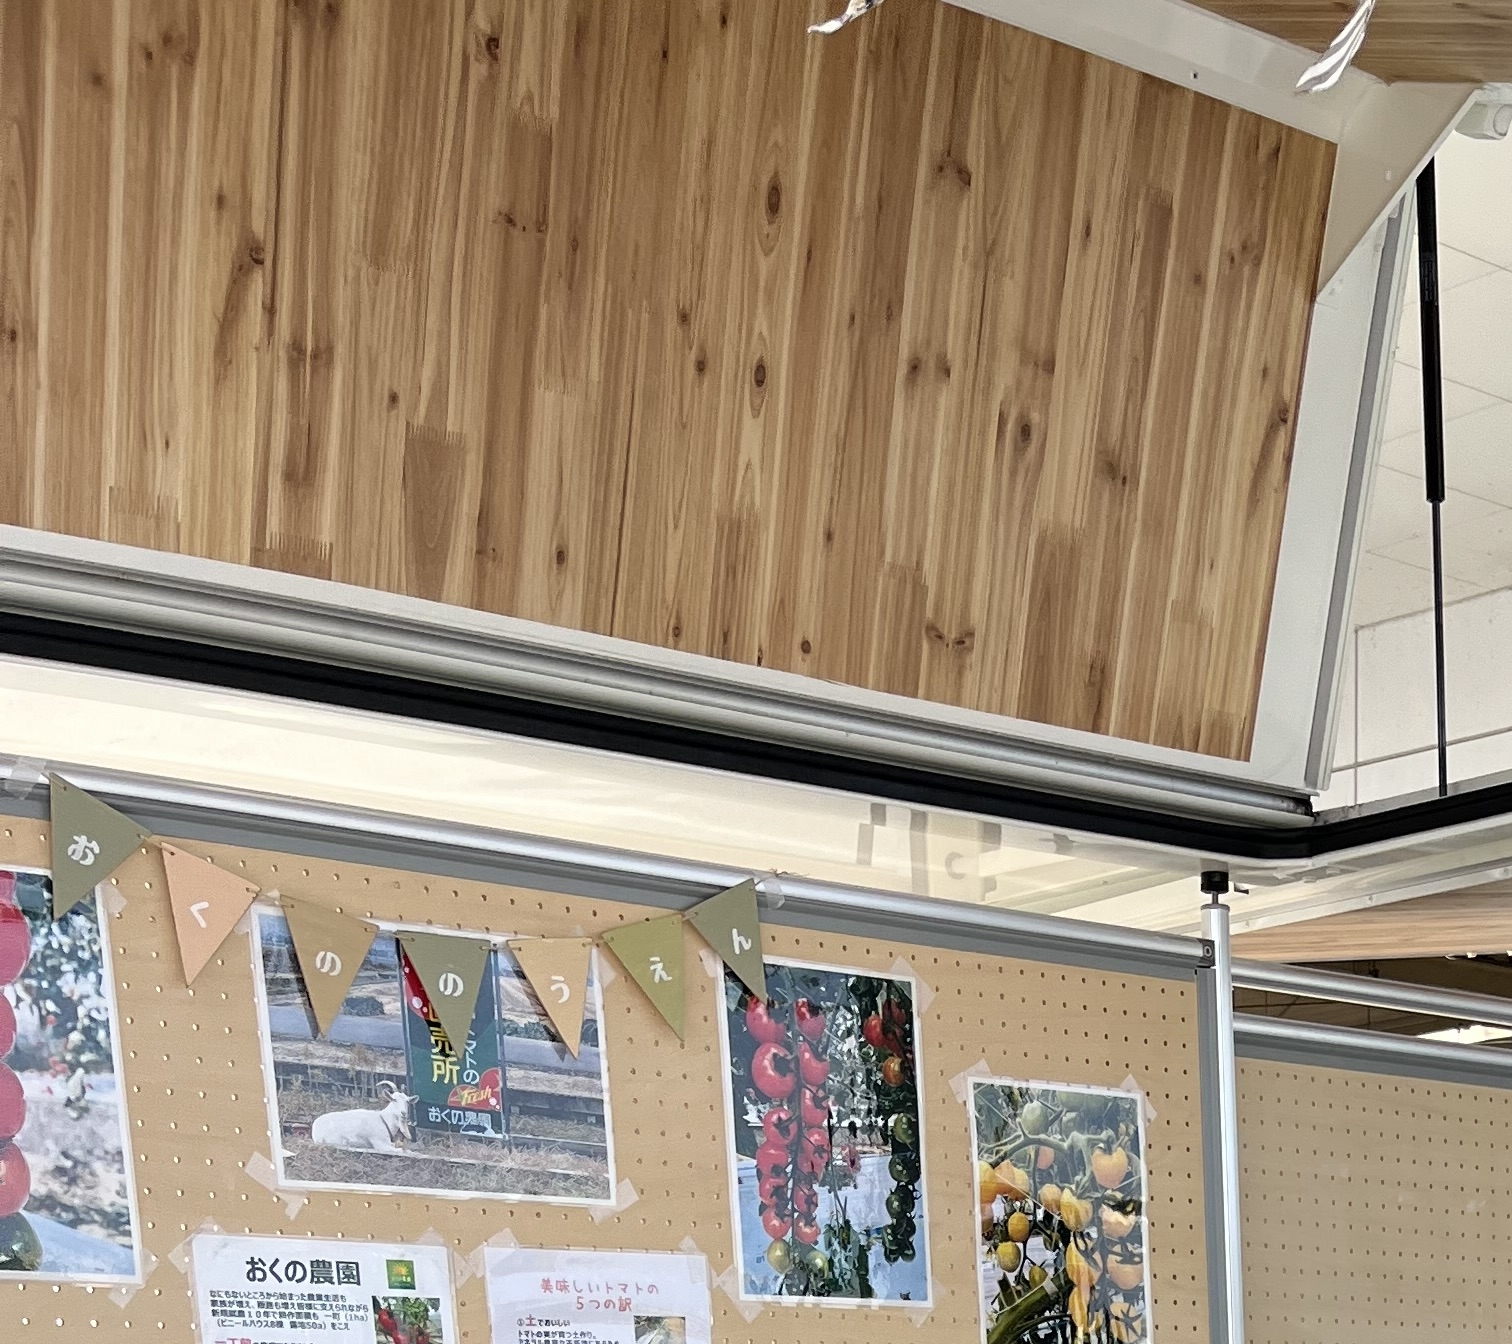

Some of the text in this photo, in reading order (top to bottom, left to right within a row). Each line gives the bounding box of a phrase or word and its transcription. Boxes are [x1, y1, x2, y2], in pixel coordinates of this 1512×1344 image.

[245, 1256, 361, 1286] おくの農園
[540, 1278, 659, 1294] 美味しいトマトの
